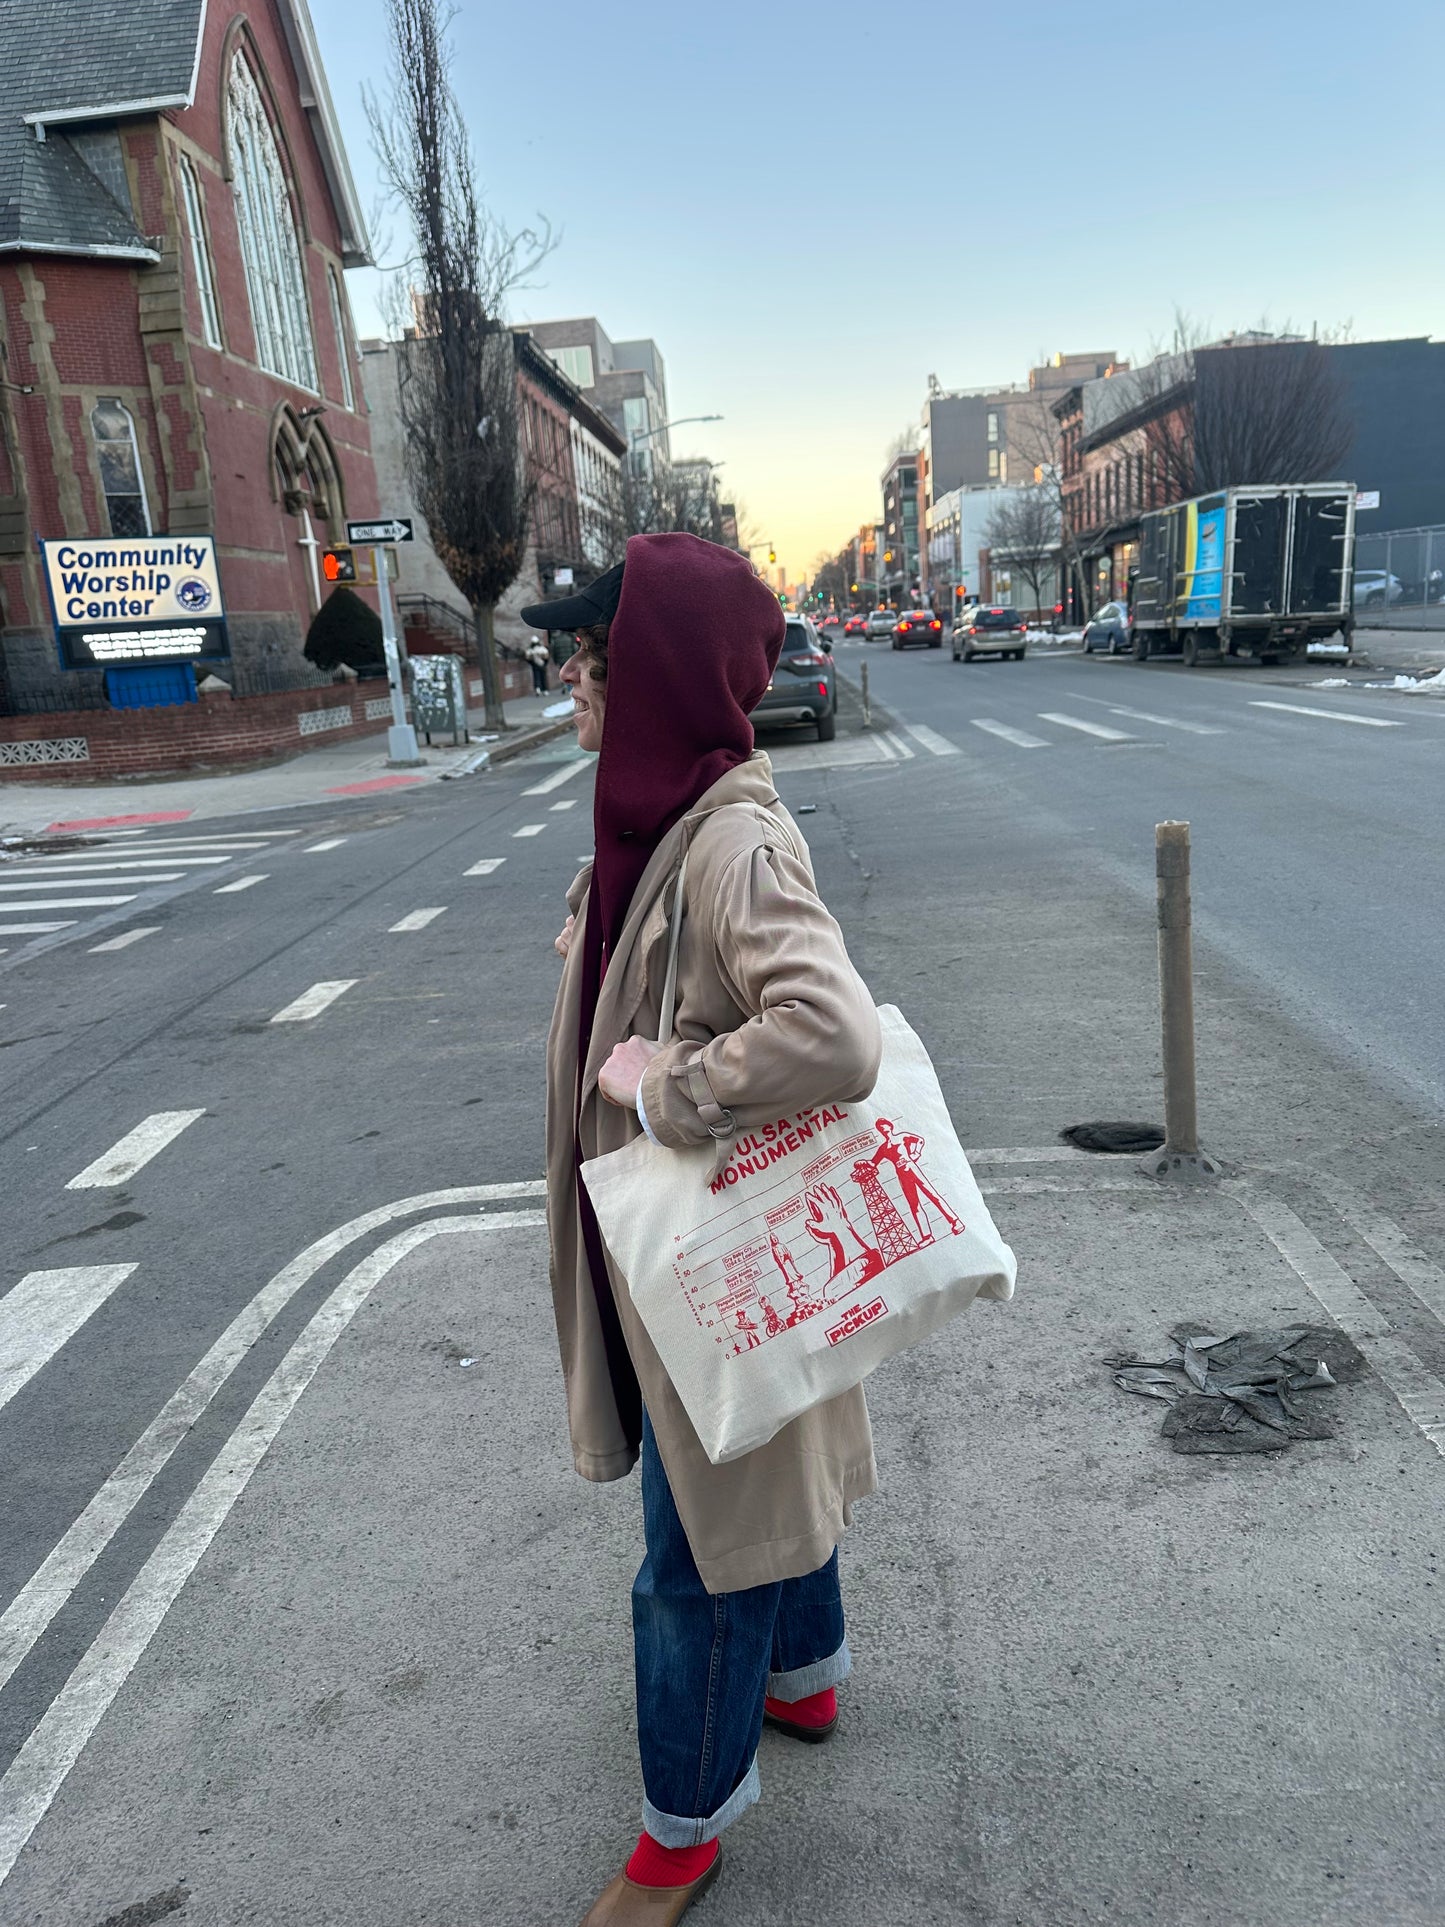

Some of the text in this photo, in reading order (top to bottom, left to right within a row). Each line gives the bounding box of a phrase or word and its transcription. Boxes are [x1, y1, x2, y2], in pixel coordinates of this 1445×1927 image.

[356, 526, 403, 538] ONE WAY
[57, 543, 207, 569] Community
[61, 570, 171, 595] Worship
[67, 596, 154, 619] Center
[729, 1119, 792, 1162] ULSA
[711, 1104, 848, 1195] MONUMENTAL
[674, 1235, 681, 1243] 70
[677, 1252, 685, 1261] 60
[724, 1256, 733, 1264] Cry
[733, 1250, 744, 1259] Baby
[672, 1263, 681, 1279] FEET
[683, 1269, 691, 1277] 50
[691, 1286, 699, 1294] 40
[684, 1291, 702, 1327] MEASURED
[698, 1302, 706, 1311] 30
[841, 1304, 862, 1320] THE
[706, 1319, 714, 1328] 20
[830, 1302, 882, 1343] PICKUP
[715, 1336, 722, 1344] 10
